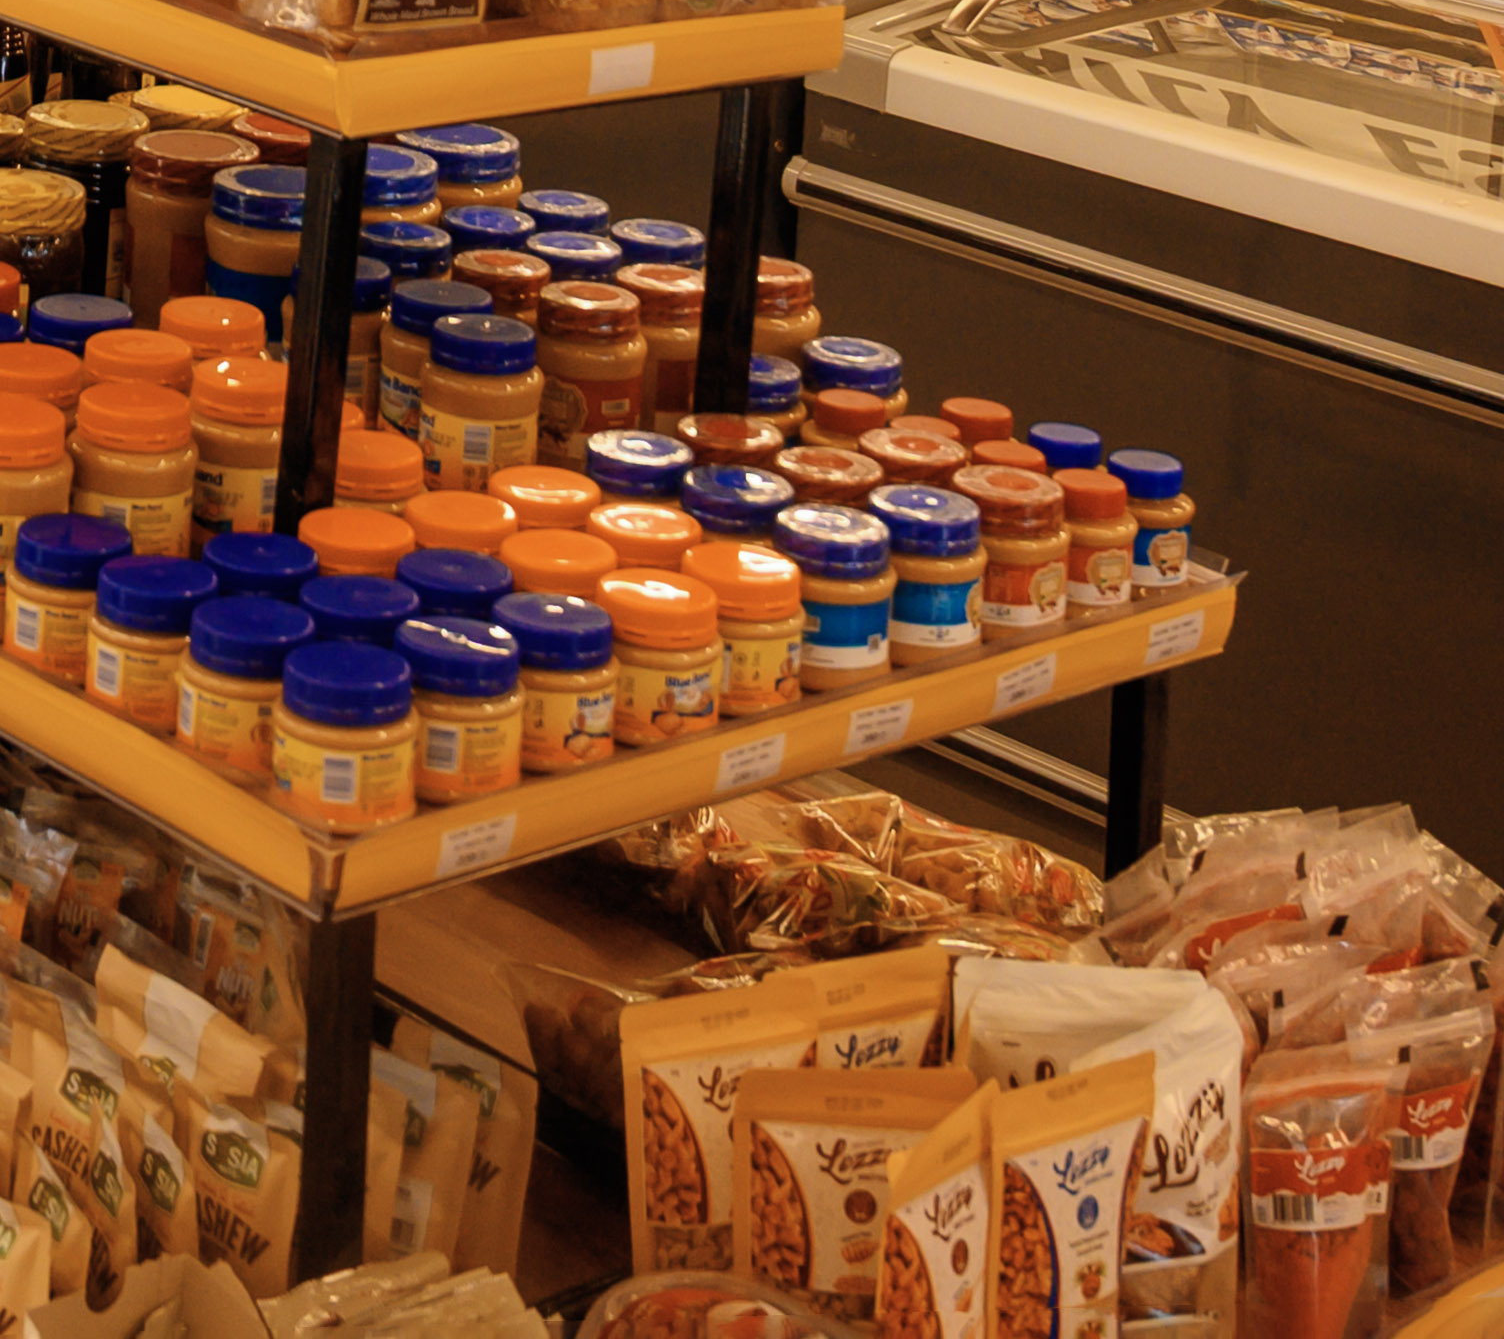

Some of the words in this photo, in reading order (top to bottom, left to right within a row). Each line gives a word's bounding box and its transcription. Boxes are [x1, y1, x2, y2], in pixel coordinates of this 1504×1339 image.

[835, 1033, 902, 1069] Lozzy
[1143, 1084, 1226, 1193] Lozzy
[1053, 1146, 1112, 1196] Lozzy
